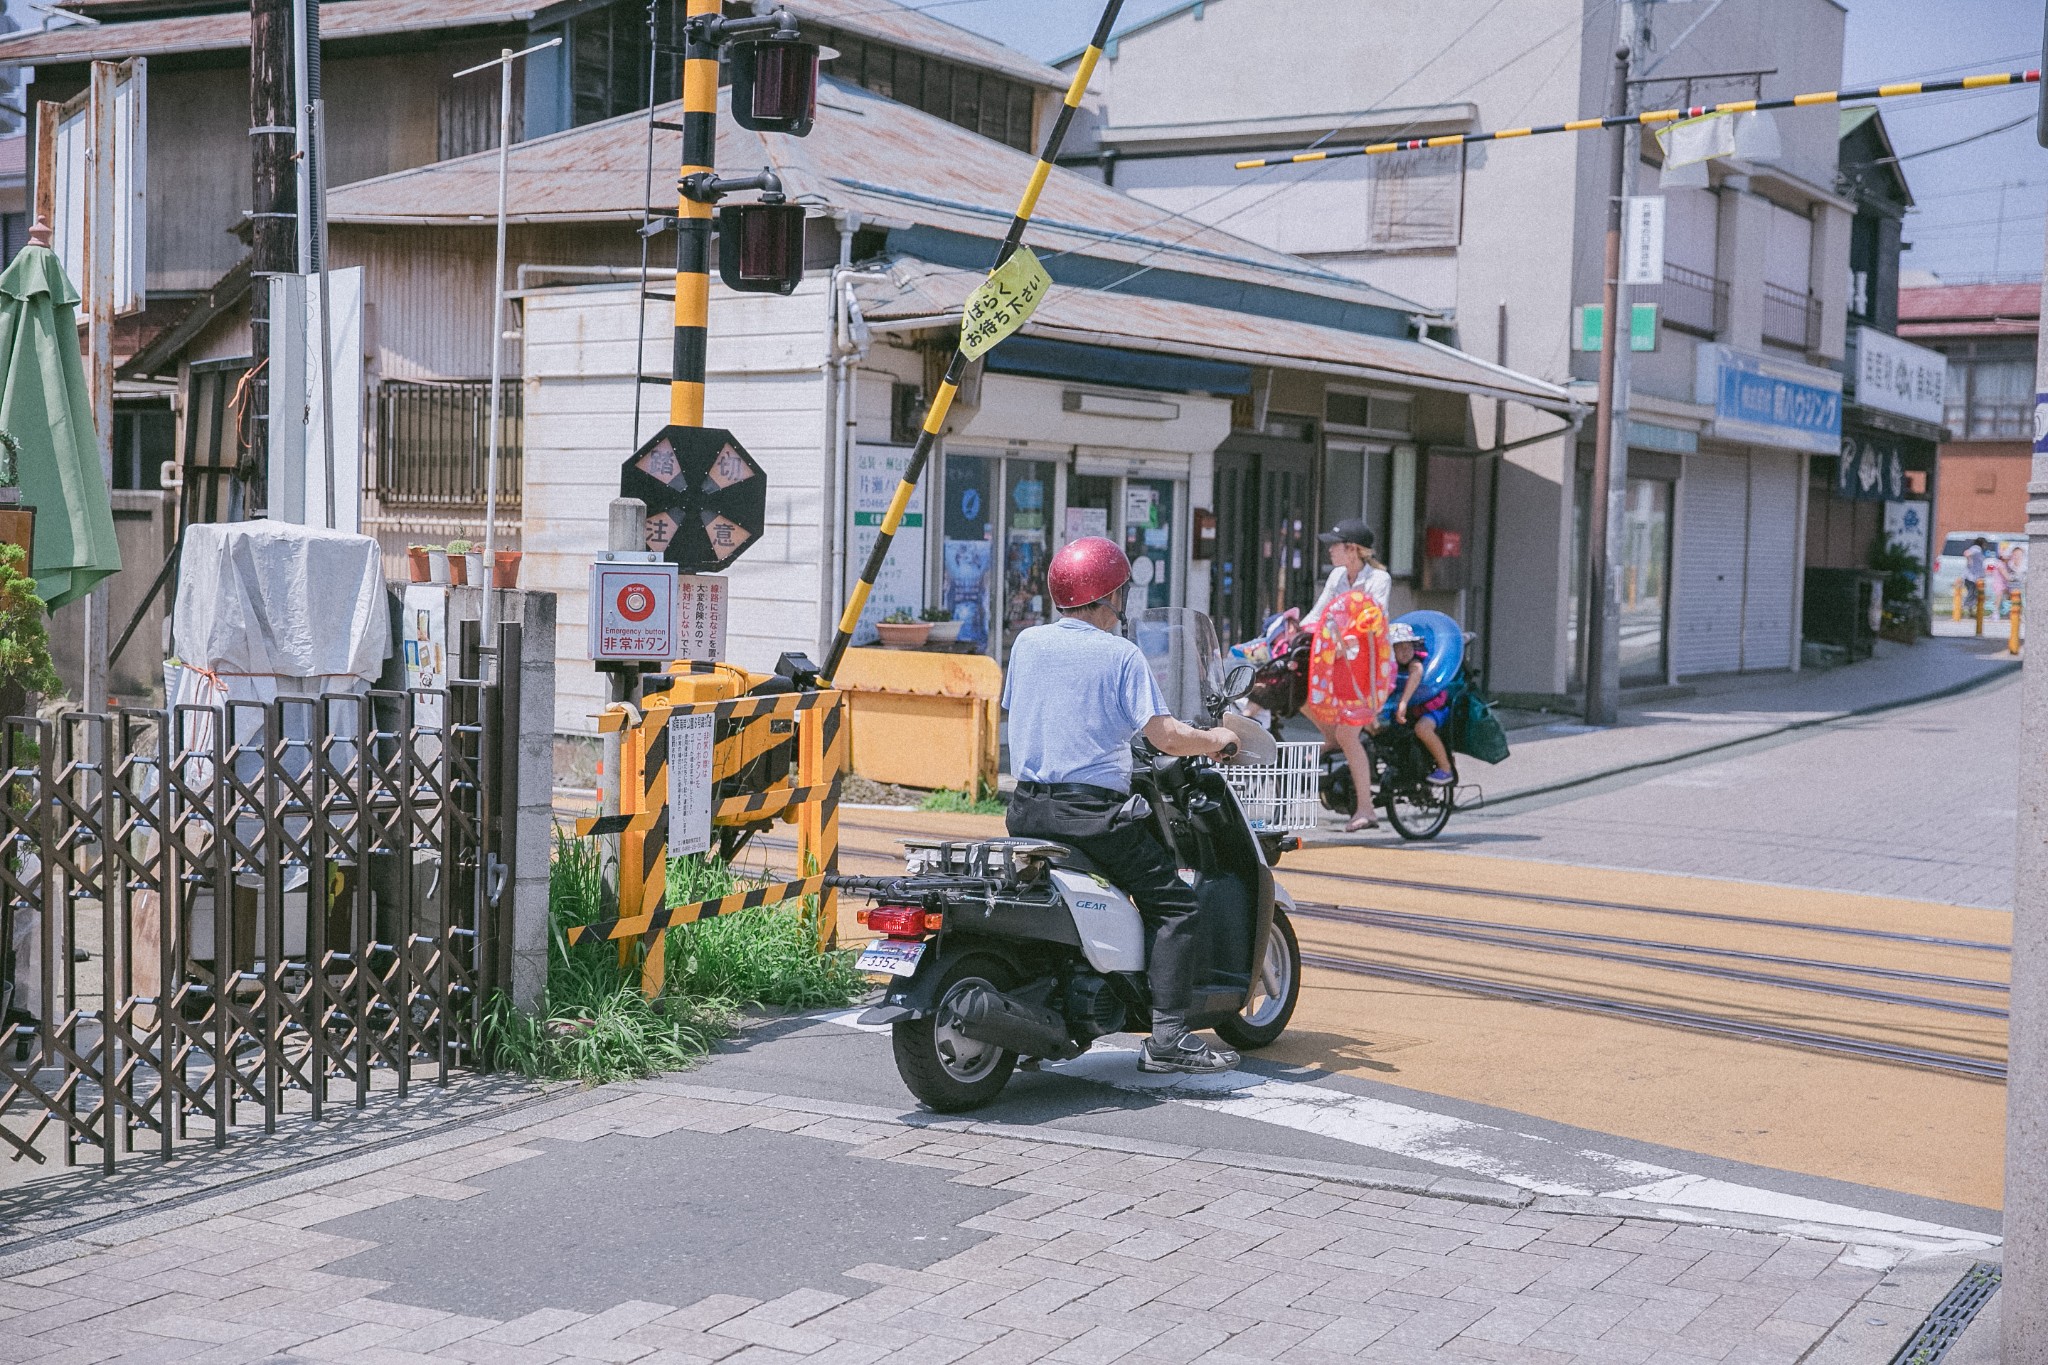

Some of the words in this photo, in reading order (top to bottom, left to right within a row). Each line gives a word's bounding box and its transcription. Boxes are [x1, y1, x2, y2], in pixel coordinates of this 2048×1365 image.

[966, 274, 1041, 347] お待ち下さい
[712, 523, 736, 547] 意
[680, 583, 692, 659] 絶対にしないで下
[695, 583, 706, 648] 大変危険なので
[604, 636, 667, 651] 非常ボタン
[605, 627, 642, 636] Emergency
[1075, 900, 1107, 911] GEAR
